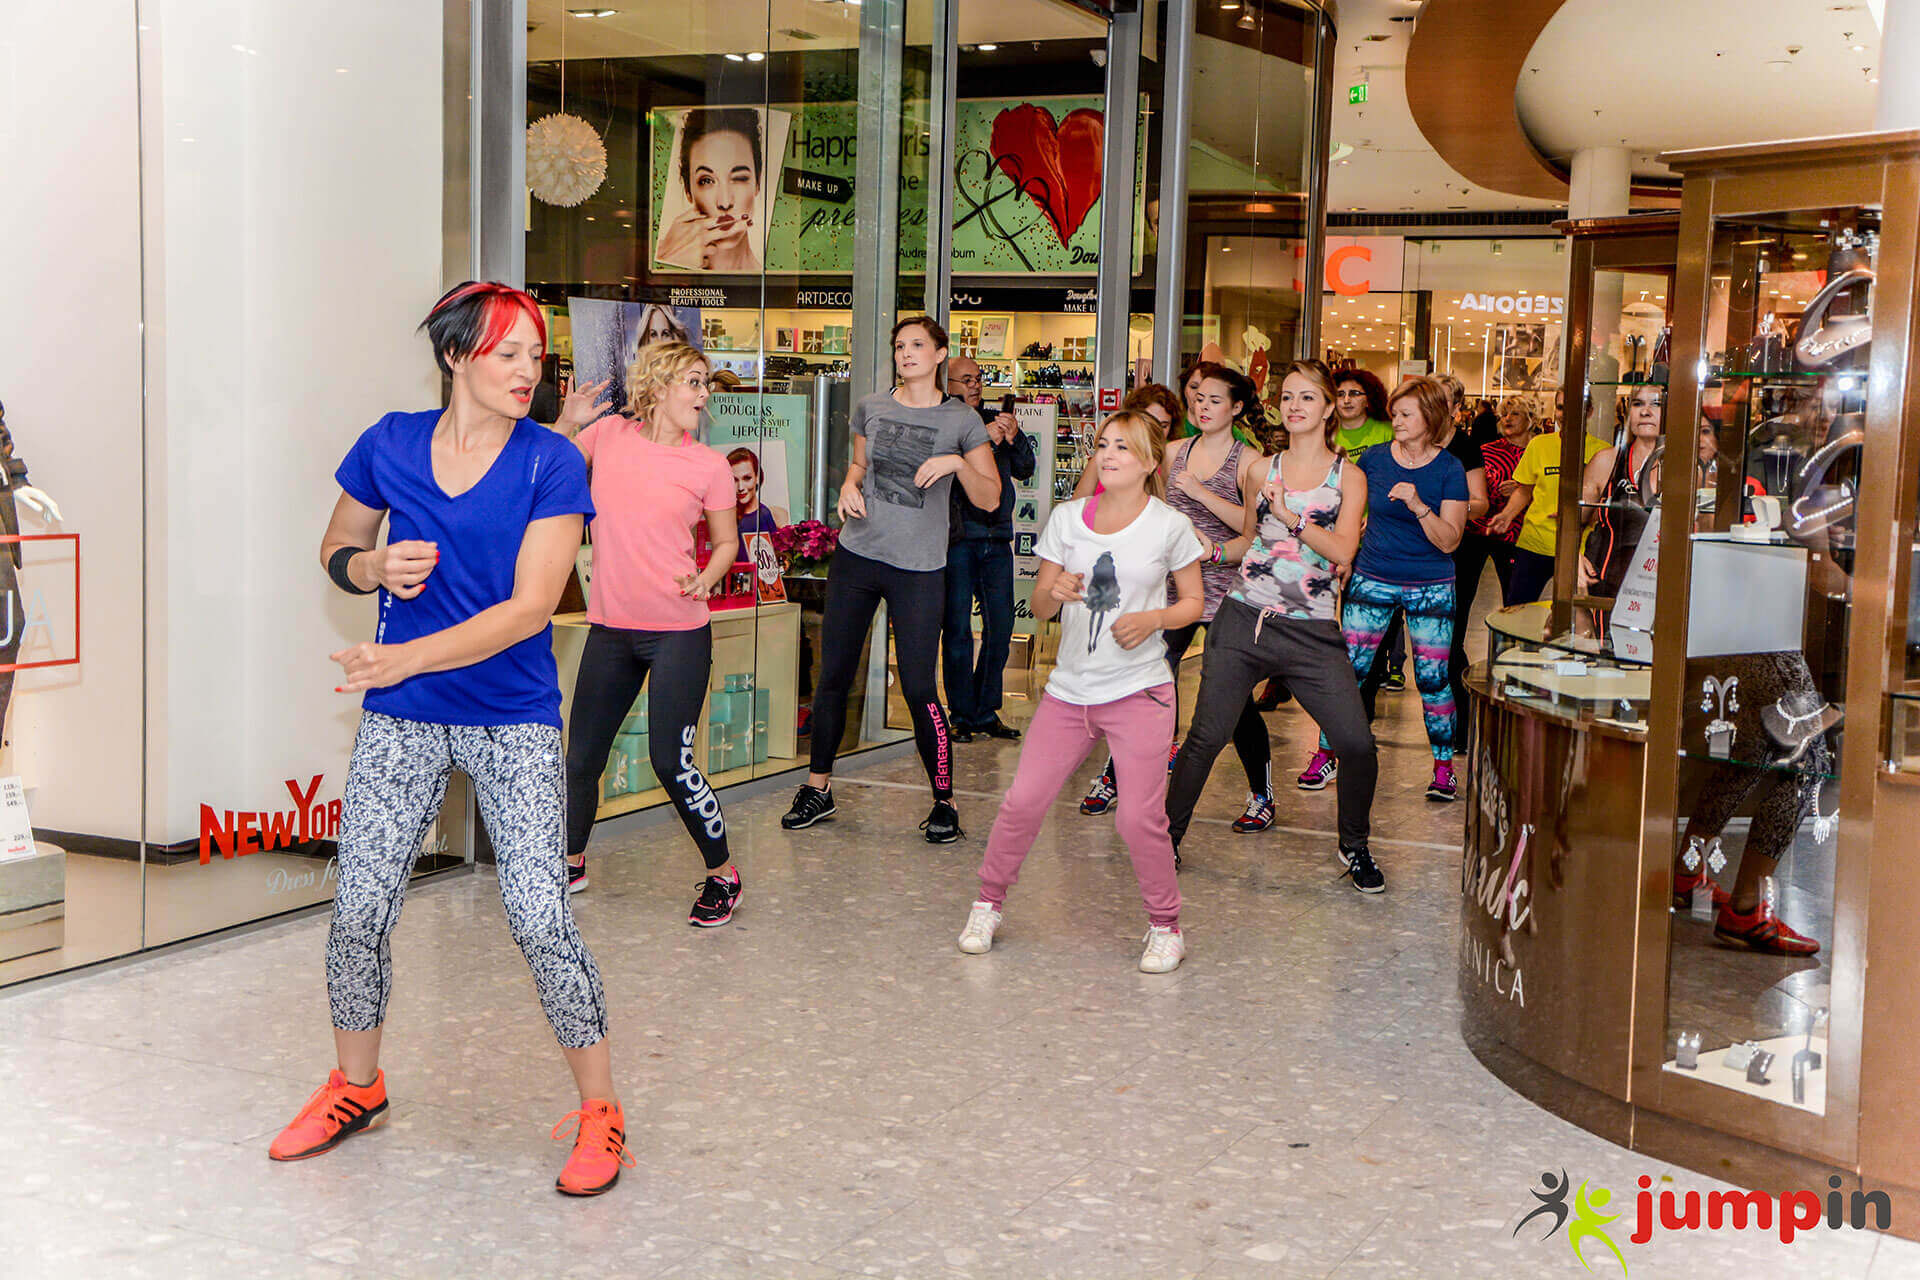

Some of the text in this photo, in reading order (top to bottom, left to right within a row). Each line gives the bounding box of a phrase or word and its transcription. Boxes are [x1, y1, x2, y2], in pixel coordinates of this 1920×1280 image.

[797, 177, 839, 195] MAKE UP
[670, 288, 725, 297] PROFESSIONAL
[796, 292, 853, 306] ARTDECO
[670, 298, 725, 306] BEAUTY TOOLS
[1064, 303, 1087, 313] MAKE
[927, 702, 949, 776] ENERGETICS
[676, 725, 725, 839] adidas
